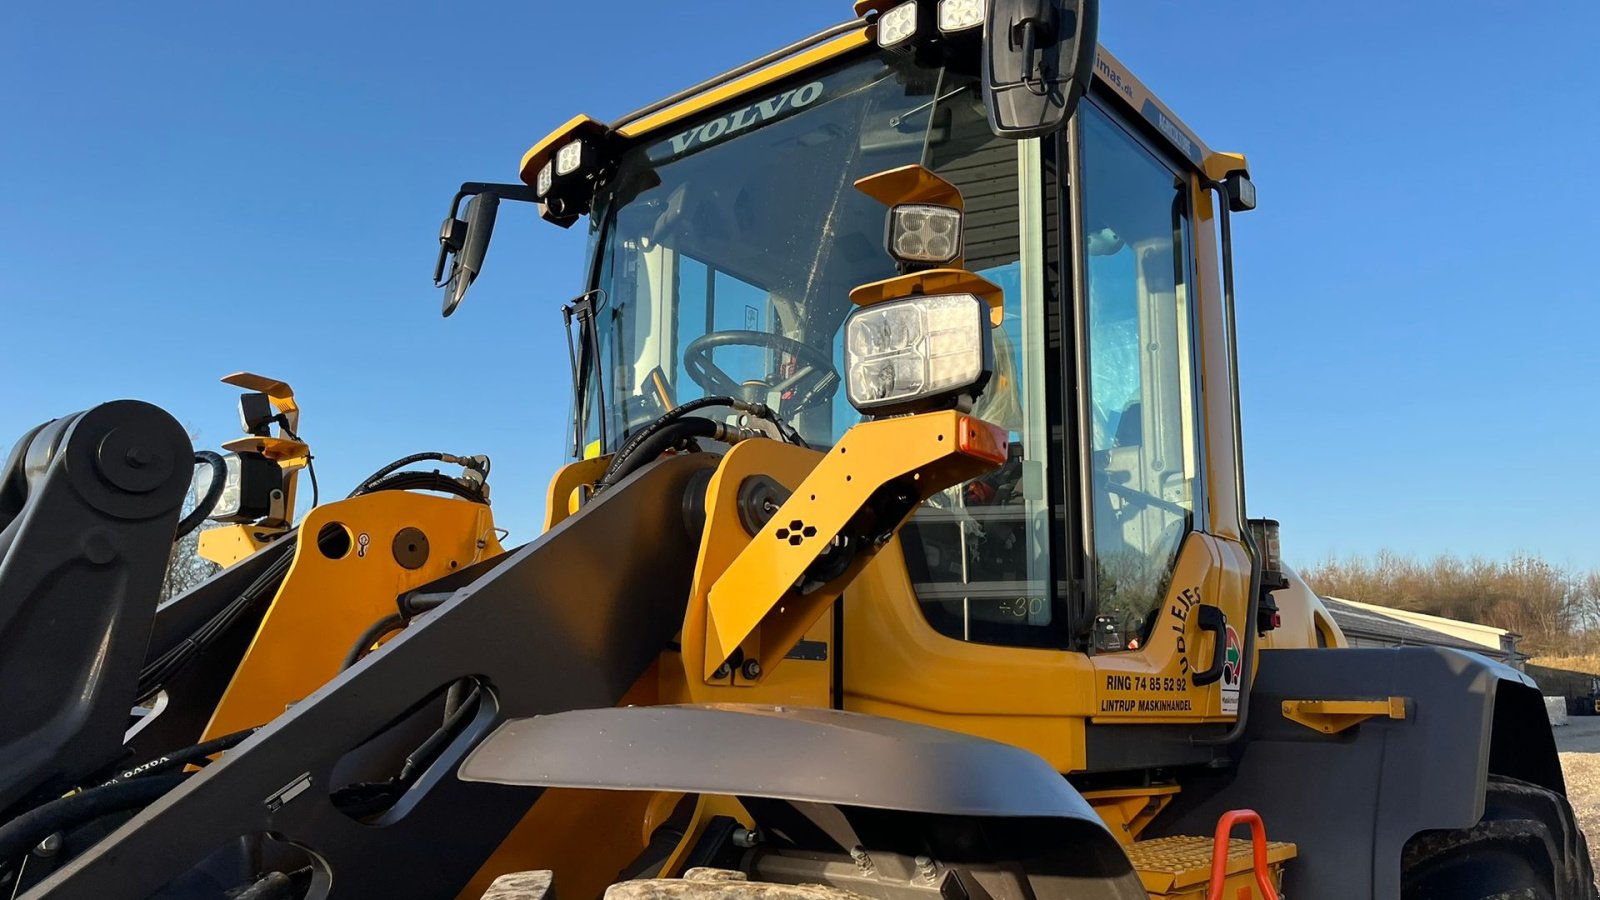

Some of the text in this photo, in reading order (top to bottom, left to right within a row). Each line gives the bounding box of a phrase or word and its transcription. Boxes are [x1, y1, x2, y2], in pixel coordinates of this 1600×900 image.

[1094, 54, 1134, 98] imas.dk
[668, 81, 824, 154] VOLVO
[1106, 675, 1187, 692] RING 74 85 52 92
[1101, 699, 1192, 712] LINTRUP MASKINHANDEL
[123, 756, 170, 778] VOLVO
